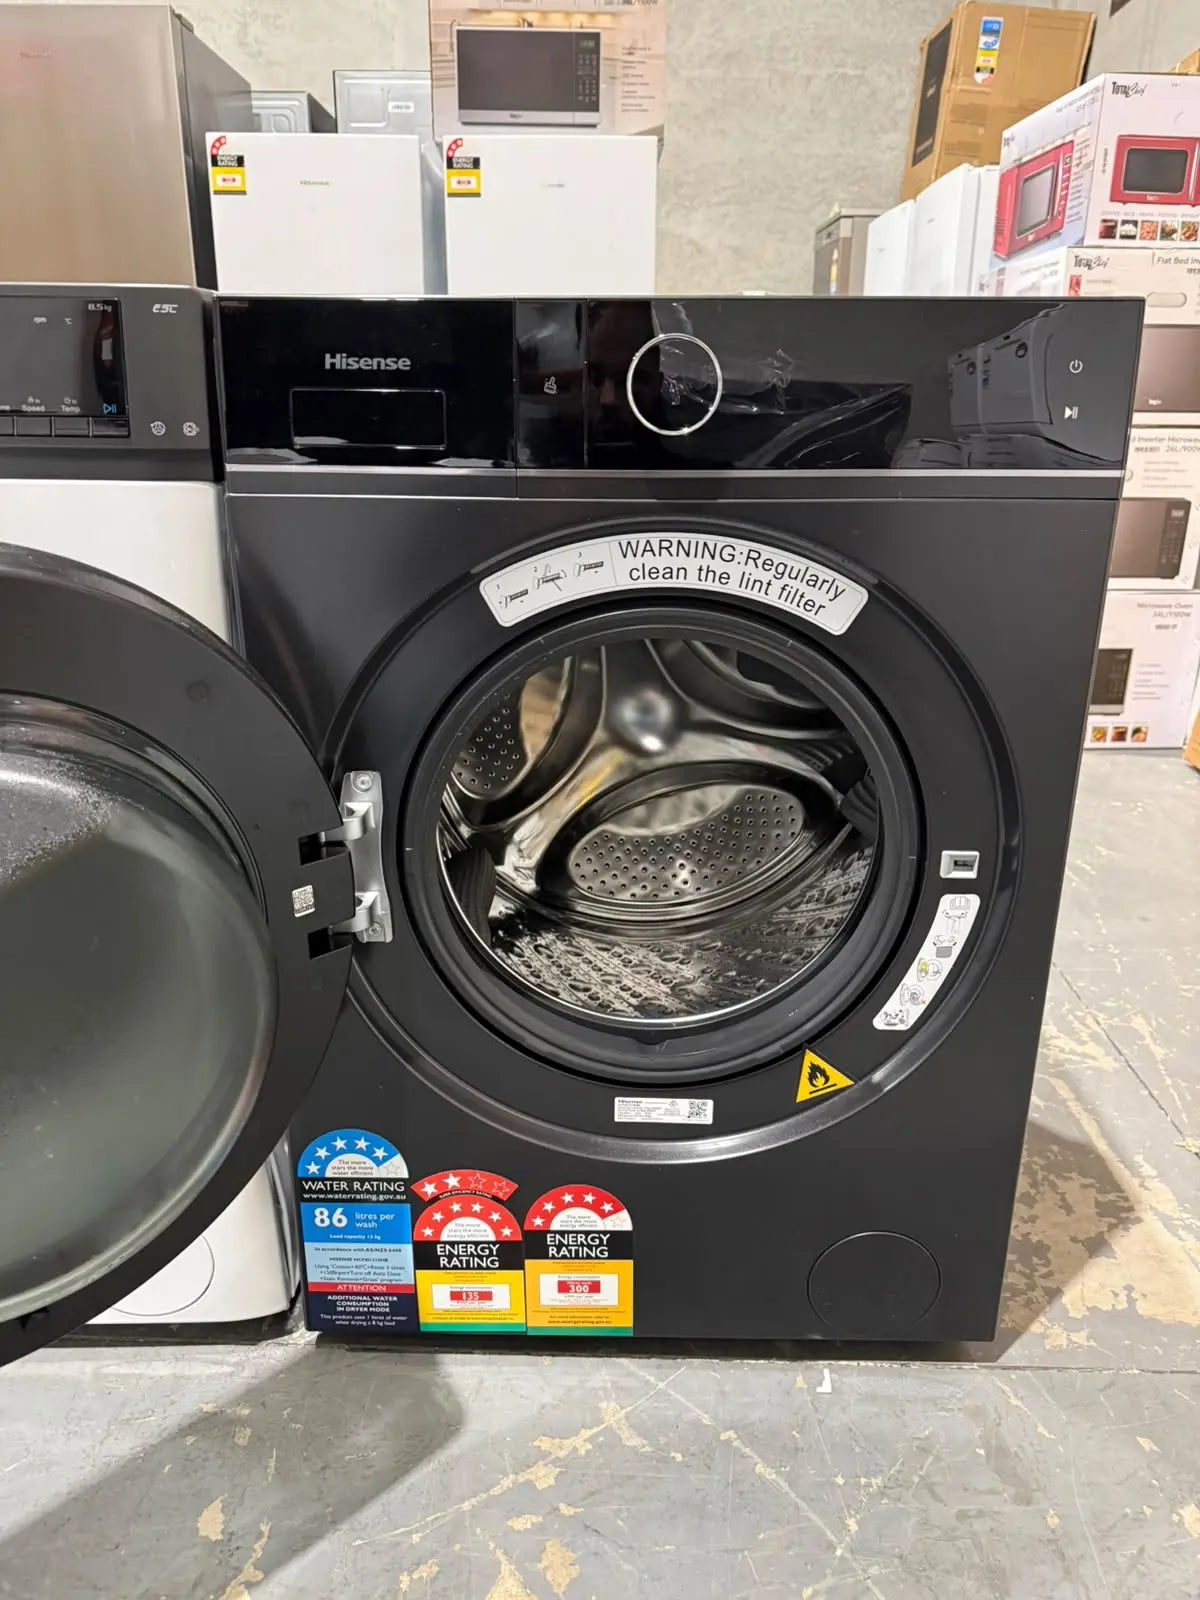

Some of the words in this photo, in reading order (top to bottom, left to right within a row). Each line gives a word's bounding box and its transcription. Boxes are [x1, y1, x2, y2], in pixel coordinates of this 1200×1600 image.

[324, 353, 412, 370] Hisense
[22, 404, 46, 413] Speed
[61, 405, 80, 414] Temp
[629, 562, 688, 581] clean
[697, 564, 731, 586] the
[738, 571, 772, 596] lint
[778, 584, 826, 616] filter
[302, 1180, 349, 1190] WATER
[354, 1181, 404, 1192] RATING
[303, 1192, 406, 1201] www.waterrating.gov.au
[314, 1208, 348, 1228] 86
[355, 1212, 377, 1220] litres
[380, 1212, 395, 1222] per
[355, 1220, 378, 1228] wash
[546, 1234, 610, 1245] ENERGY
[436, 1244, 500, 1255] ENERGY
[548, 1246, 608, 1258] RATING
[440, 1256, 500, 1268] RATING
[336, 1284, 386, 1292] ATTENTION
[568, 1284, 590, 1292] 300
[462, 1292, 480, 1300] 135
